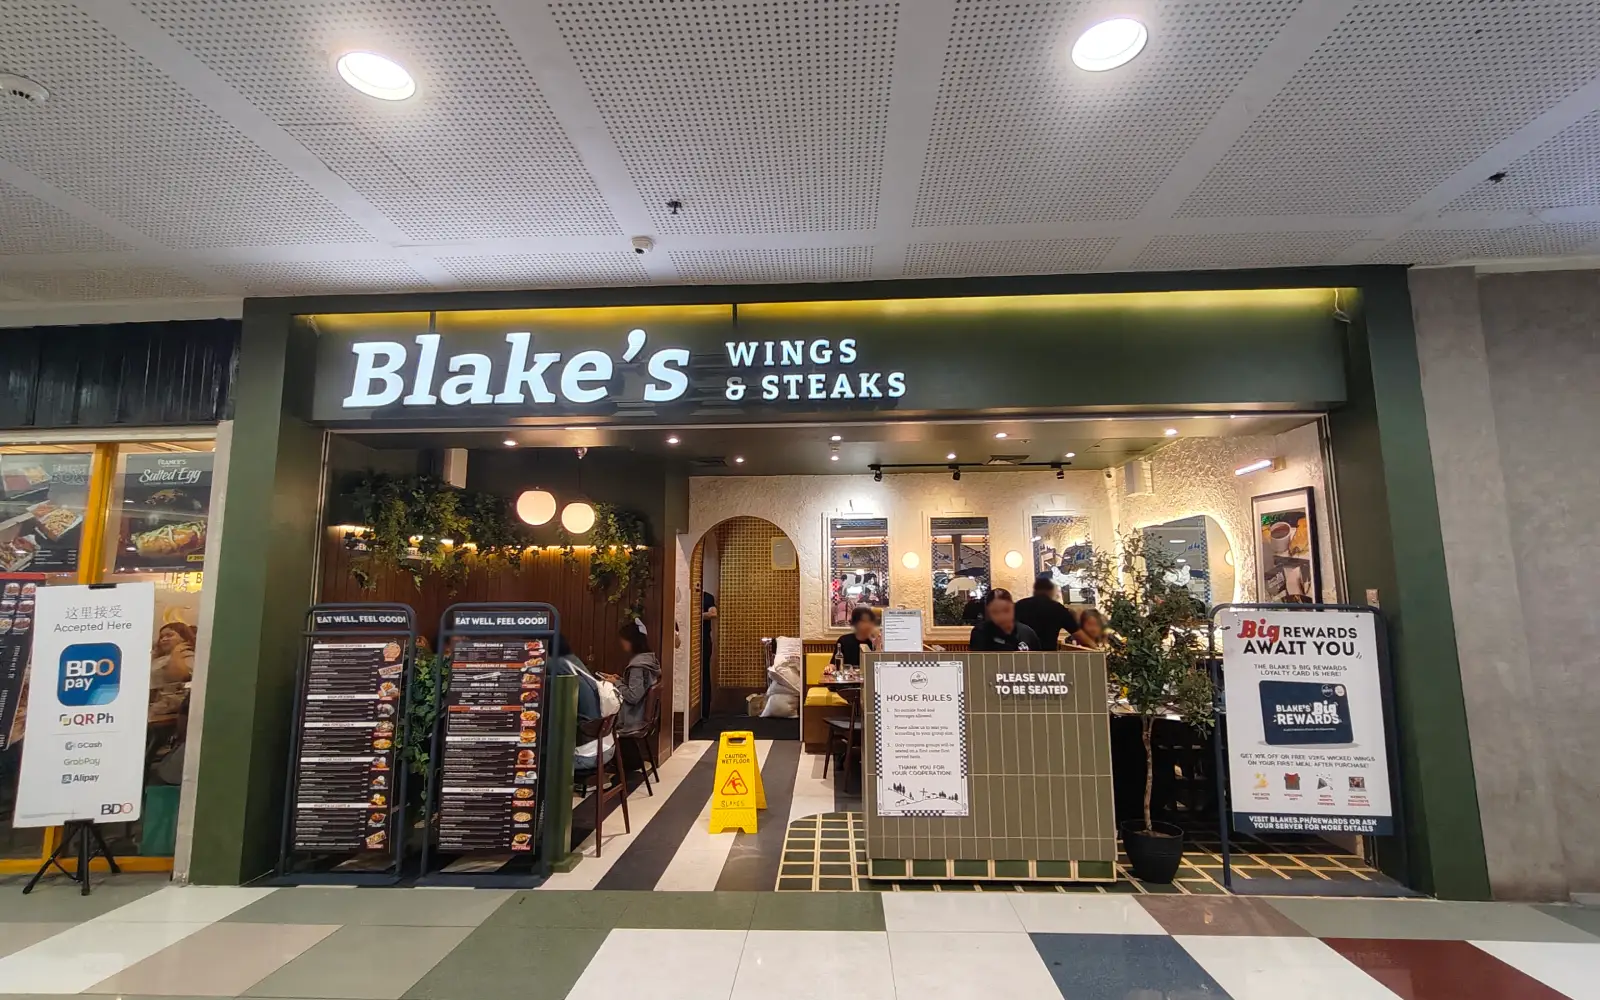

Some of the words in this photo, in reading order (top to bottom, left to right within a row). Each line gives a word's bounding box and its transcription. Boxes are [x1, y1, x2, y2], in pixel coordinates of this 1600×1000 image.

[725, 339, 858, 368] WINGS
[342, 328, 691, 408] Blake's
[726, 377, 744, 400] &
[761, 372, 907, 400] STEAKS
[139, 468, 176, 483] Salted
[177, 468, 201, 483] Egg
[65, 604, 122, 620] 这里接受
[54, 622, 103, 632] Accepted
[108, 622, 132, 630] Here
[471, 618, 495, 626] WELL,
[1237, 618, 1280, 643] Big
[1283, 626, 1357, 638] REWARDS
[1243, 640, 1306, 654] AWAIT
[1313, 641, 1354, 655] YOU
[66, 658, 114, 676] BDO
[65, 678, 94, 691] pay
[996, 674, 1035, 682] PLEASE
[1037, 674, 1065, 682] WAIT
[995, 686, 1010, 695] TO
[1013, 686, 1026, 695] BE
[1028, 686, 1068, 695] SEATED
[1312, 700, 1336, 715] Big
[73, 714, 94, 726] QR
[97, 713, 114, 724] Ph
[1277, 714, 1340, 724] REWARDS
[64, 758, 100, 766] GrabPay
[73, 774, 100, 782] Alipay
[101, 803, 133, 815] BDO
[1270, 816, 1348, 824] BLAKES.PH/REWARDS
